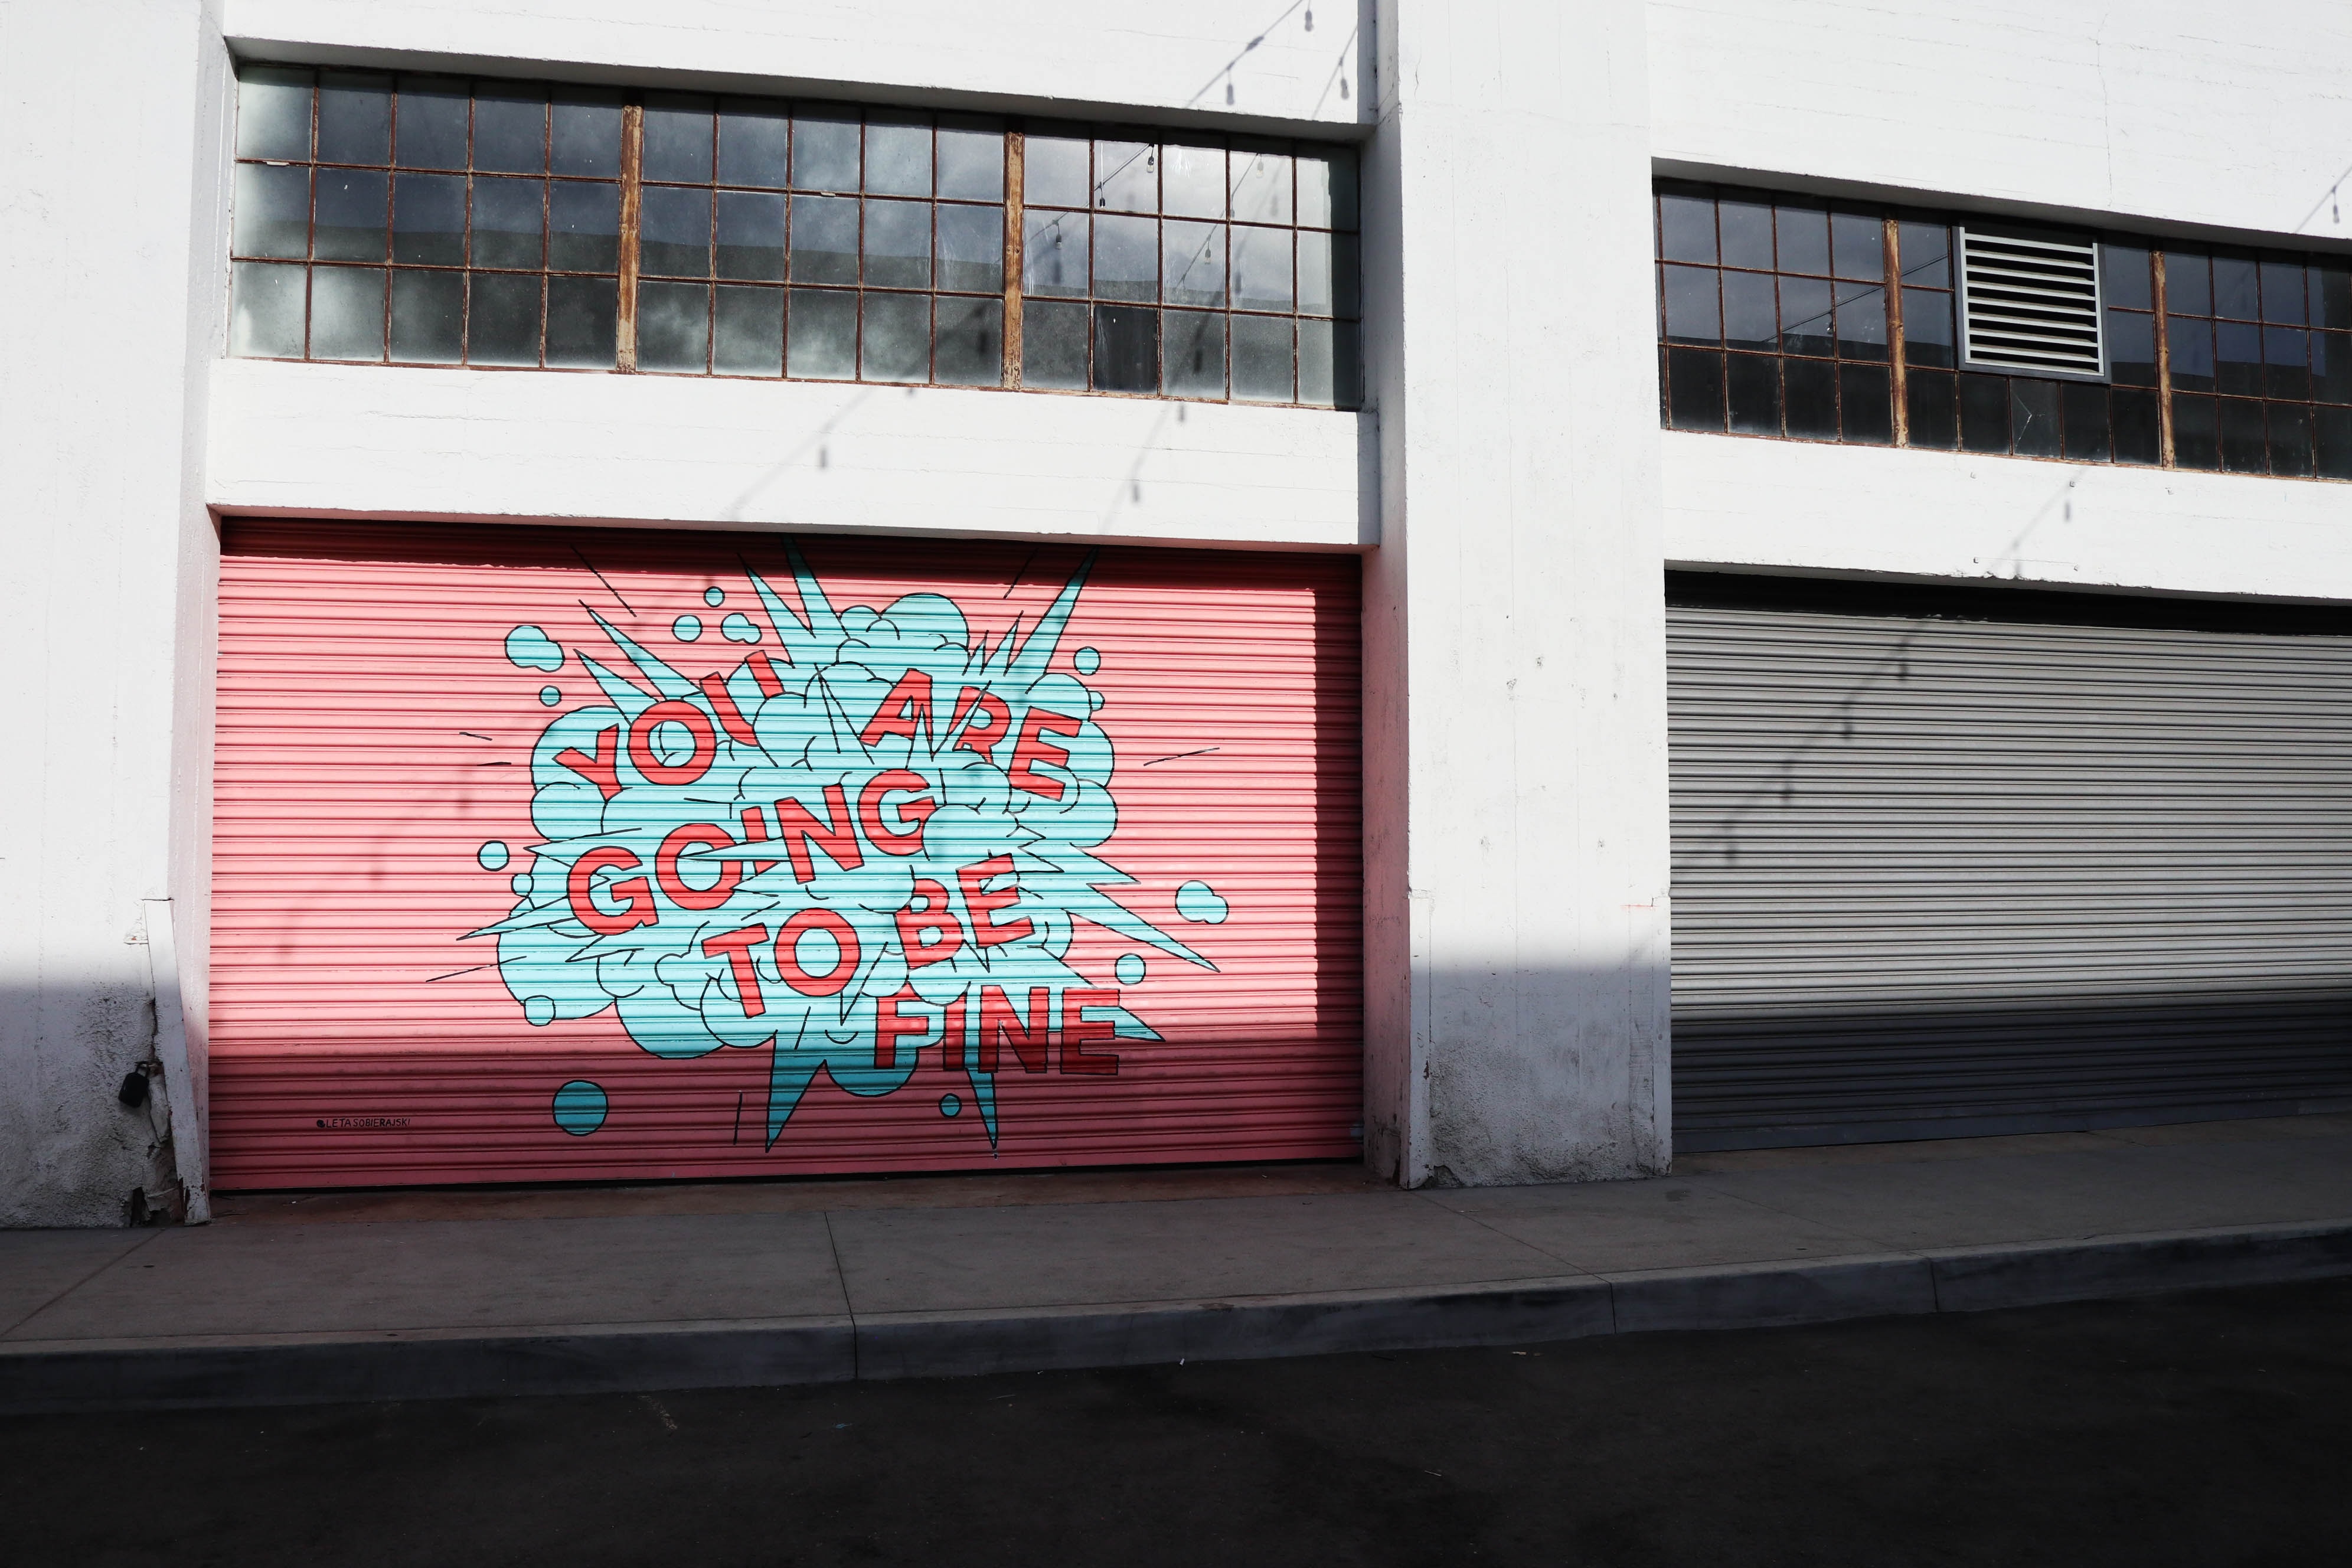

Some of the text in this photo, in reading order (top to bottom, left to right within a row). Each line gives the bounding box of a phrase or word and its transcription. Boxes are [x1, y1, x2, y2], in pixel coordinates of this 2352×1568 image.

[553, 650, 1083, 801] YOU ARE
[567, 769, 936, 935] GOING
[703, 853, 1035, 1018] TO BE
[874, 982, 1121, 1075] FINE
